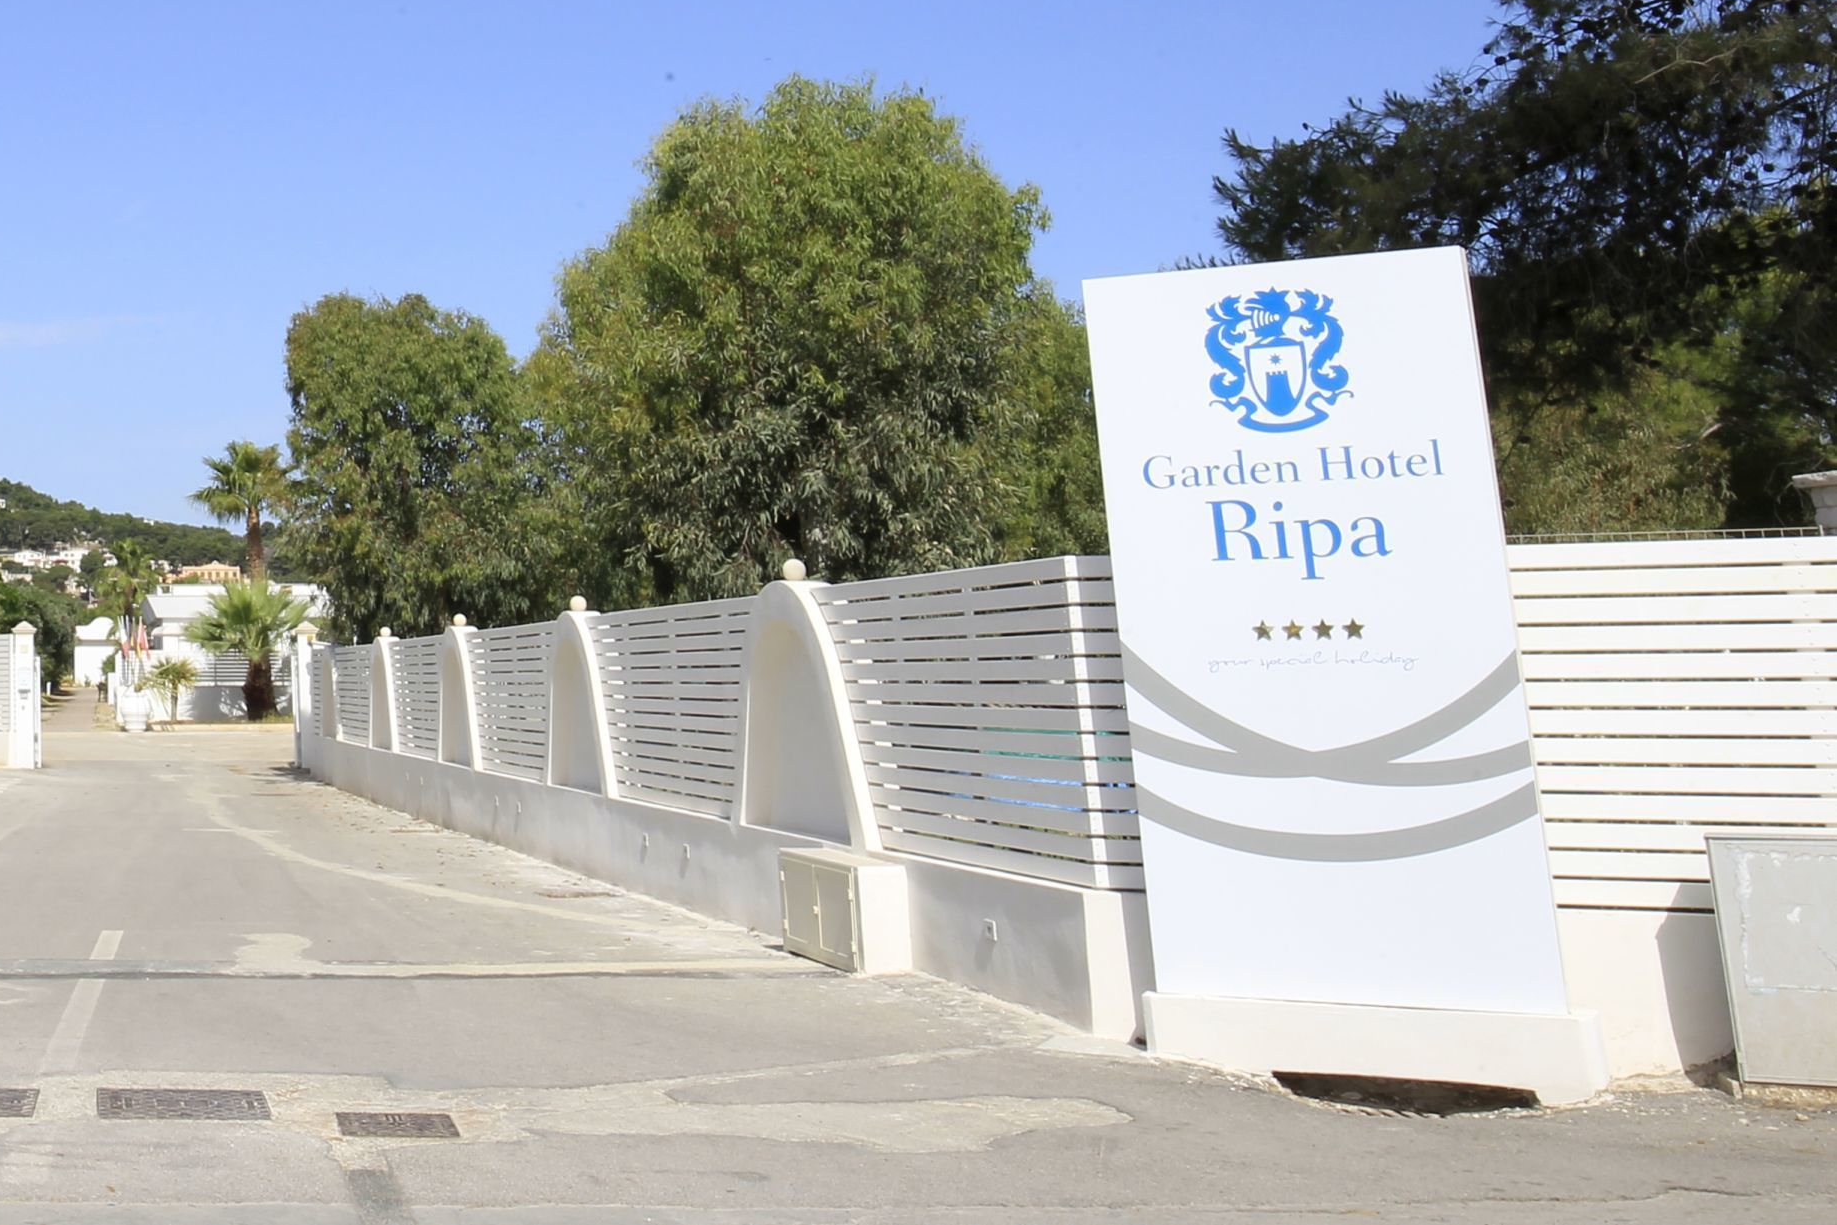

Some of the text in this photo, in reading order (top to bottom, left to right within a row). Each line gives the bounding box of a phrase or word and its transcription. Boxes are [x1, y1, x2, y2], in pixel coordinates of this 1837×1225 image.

[1142, 439, 1443, 489] Garden Hotel
[1205, 500, 1393, 580] Ripa
[1208, 650, 1419, 673] your special holiday
